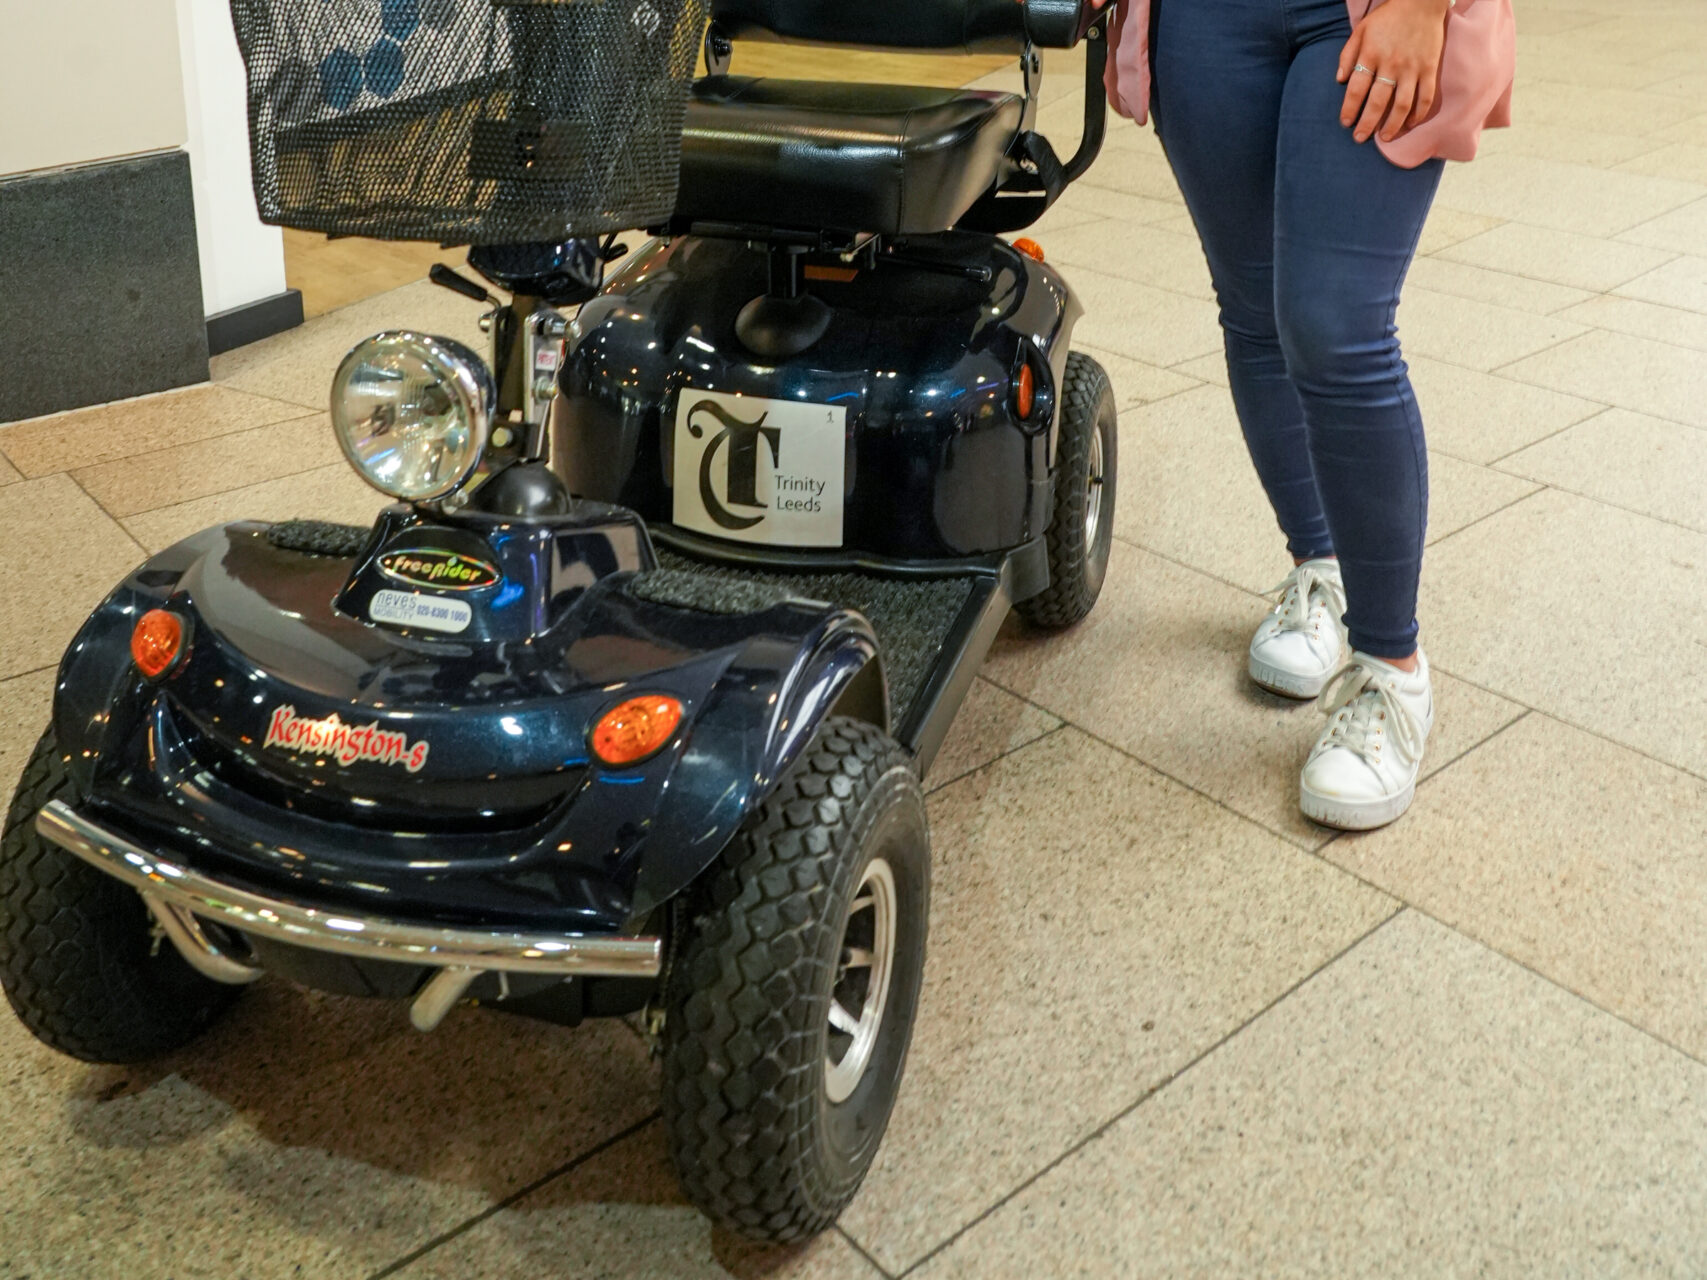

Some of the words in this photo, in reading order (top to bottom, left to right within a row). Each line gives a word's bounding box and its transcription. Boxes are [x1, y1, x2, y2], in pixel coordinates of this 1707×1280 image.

[775, 475, 826, 497] Trinity
[777, 497, 822, 513] Leeds
[377, 592, 418, 610] neves
